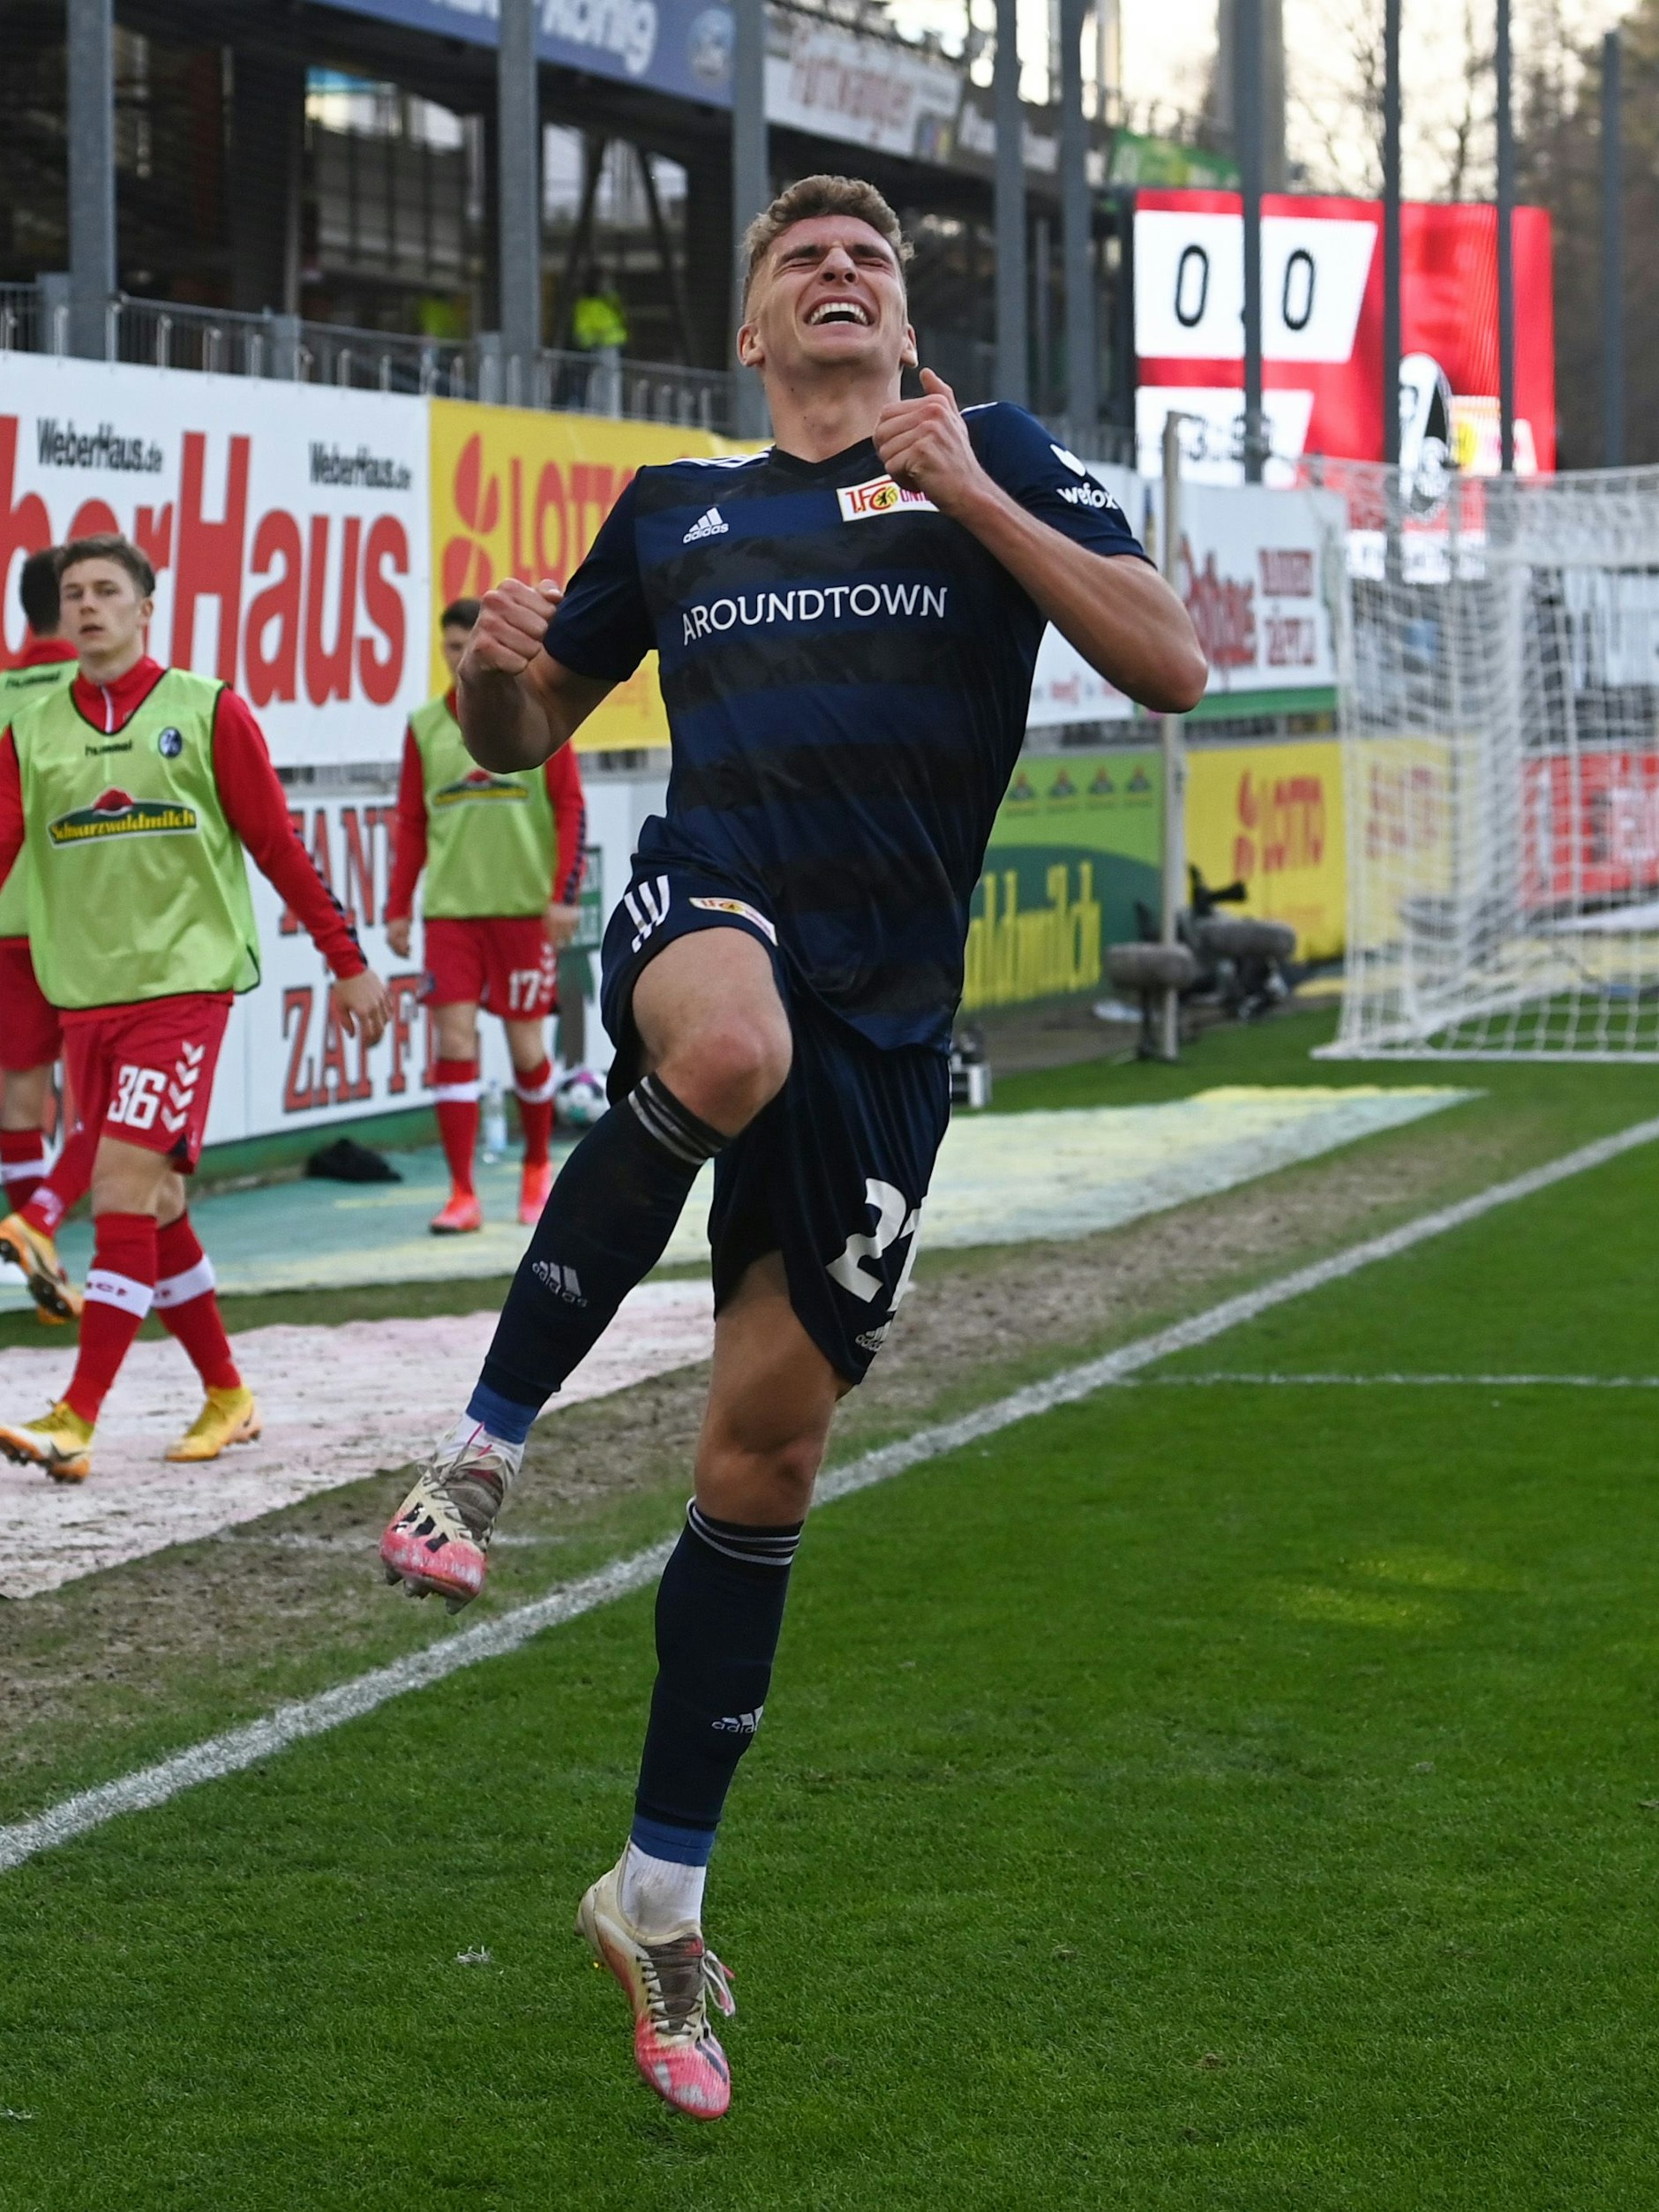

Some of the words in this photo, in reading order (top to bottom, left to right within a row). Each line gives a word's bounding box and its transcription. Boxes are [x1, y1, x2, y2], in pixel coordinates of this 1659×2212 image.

[1175, 245, 1209, 327] 0
[1282, 249, 1315, 331] 0
[36, 417, 162, 473] WeberHaus.de
[1056, 482, 1119, 510] wefox
[683, 523, 729, 544] adidas
[682, 583, 948, 646] AROUNDTOWN
[509, 970, 542, 1012] 17
[107, 1065, 168, 1130] 36
